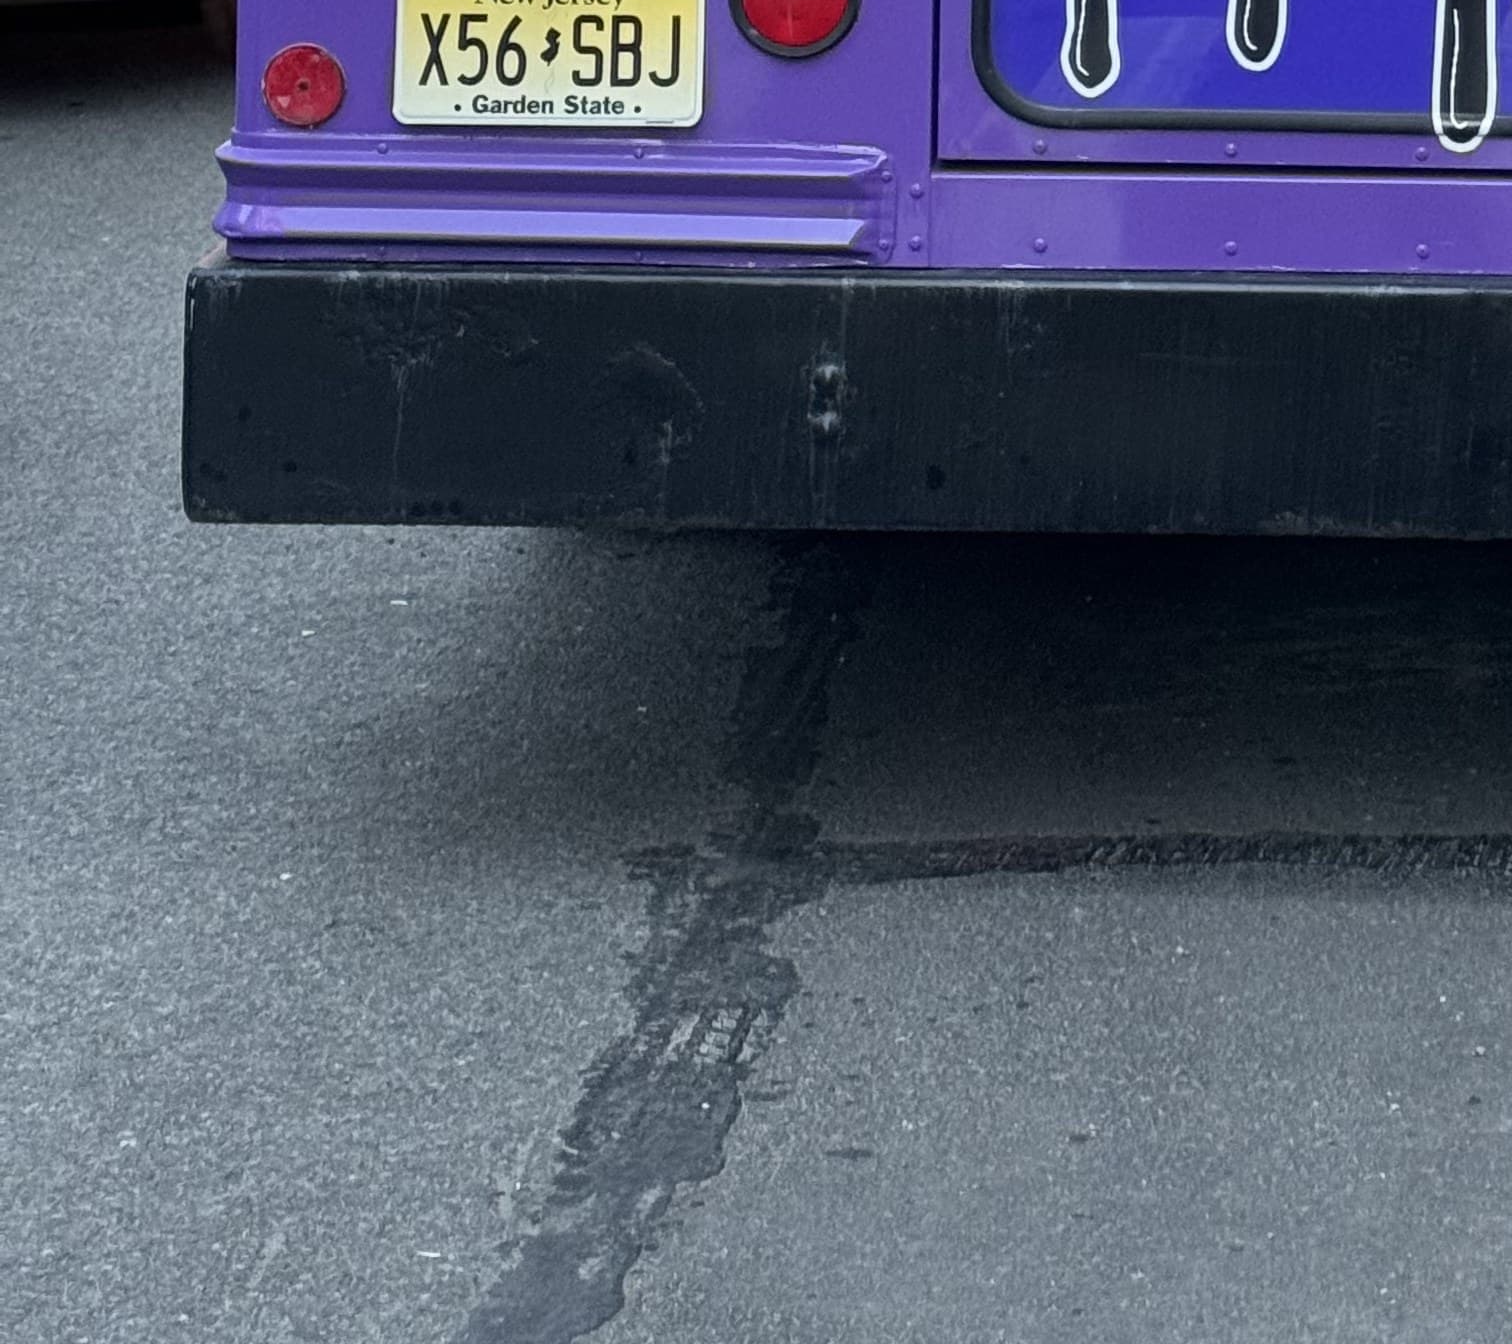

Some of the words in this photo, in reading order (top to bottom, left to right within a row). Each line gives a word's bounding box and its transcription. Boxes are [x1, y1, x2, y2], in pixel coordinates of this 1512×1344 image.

[418, 13, 527, 86] X56
[572, 14, 682, 88] SBJ
[471, 94, 554, 115] Garden
[563, 95, 625, 115] State
